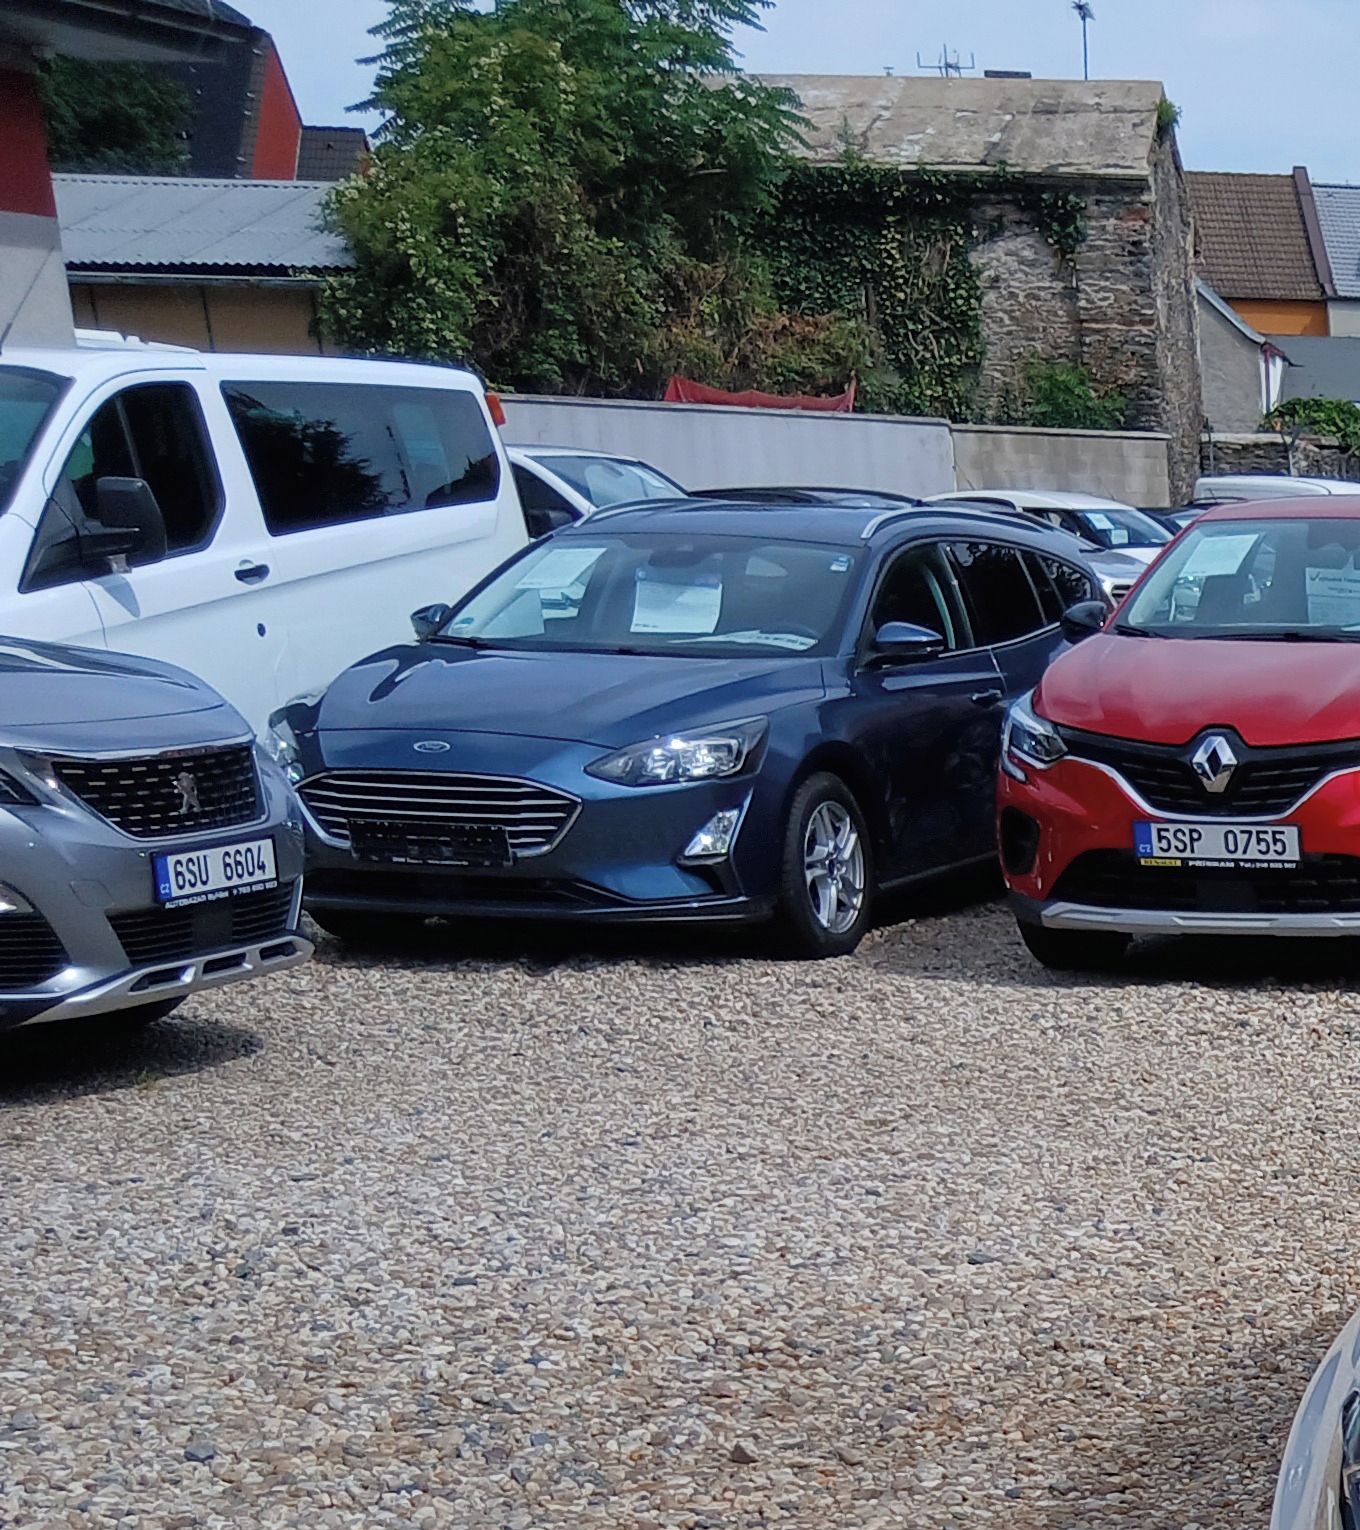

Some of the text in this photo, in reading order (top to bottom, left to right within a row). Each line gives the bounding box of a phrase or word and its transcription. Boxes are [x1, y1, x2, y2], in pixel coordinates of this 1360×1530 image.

[1138, 844, 1151, 852] CZ
[1156, 828, 1287, 855] 5SP 0755
[173, 854, 210, 890] 6SU
[222, 844, 267, 881] 6604
[160, 882, 170, 894] CZ
